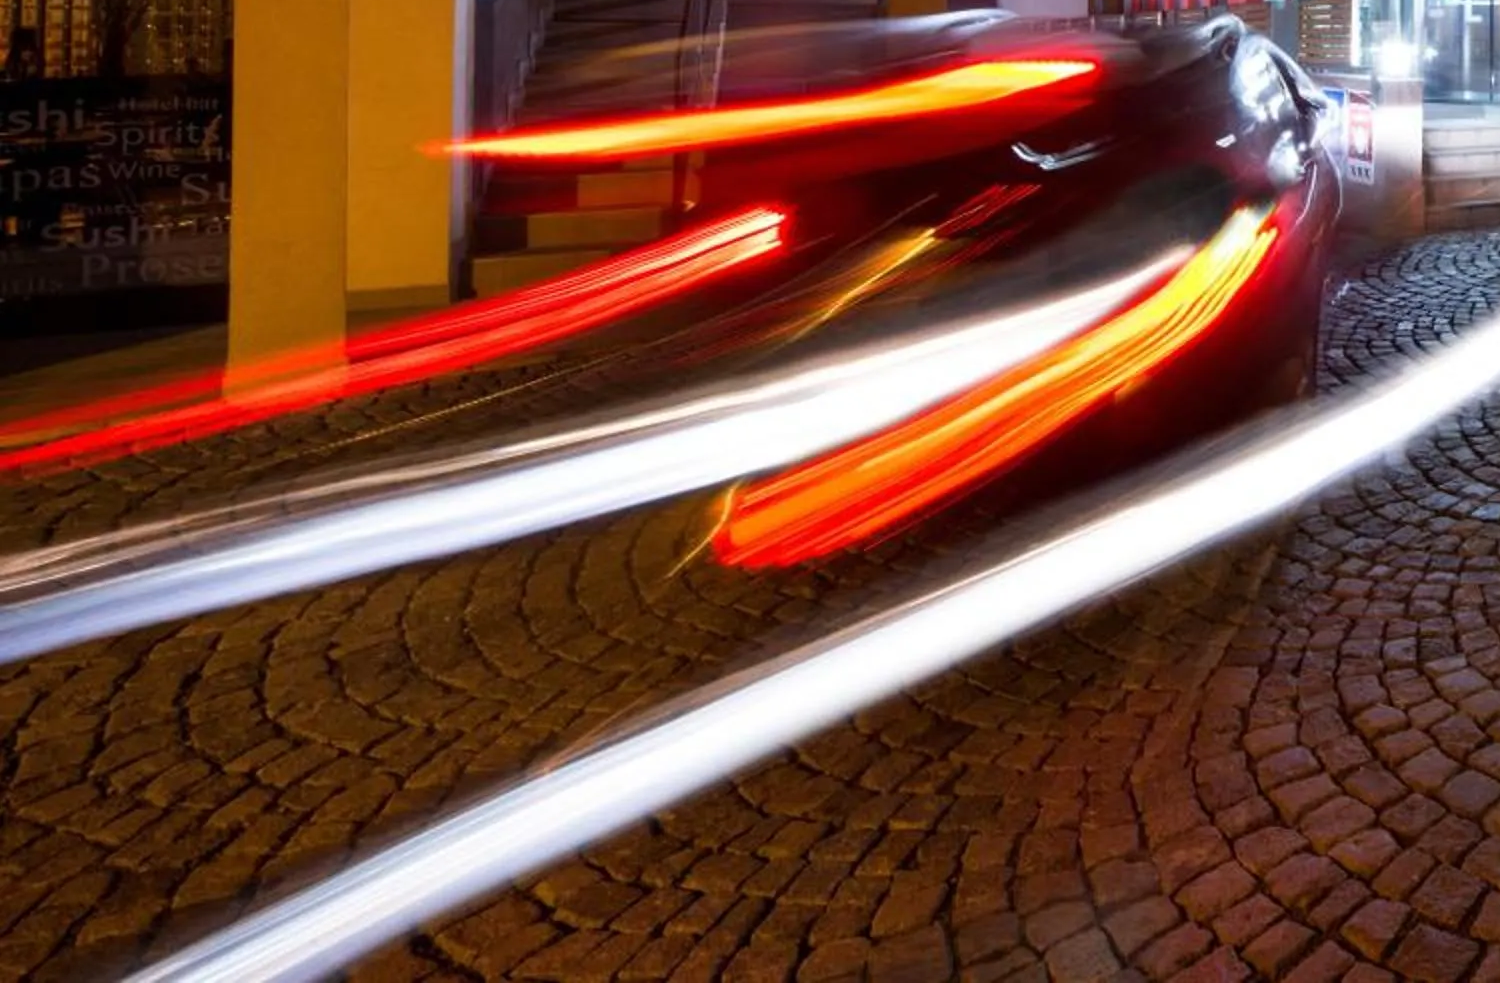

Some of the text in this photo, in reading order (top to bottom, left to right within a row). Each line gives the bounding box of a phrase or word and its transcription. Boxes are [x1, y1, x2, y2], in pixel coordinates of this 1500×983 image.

[0, 96, 84, 136] shi
[0, 163, 102, 201] pas
[106, 159, 181, 181] Wine
